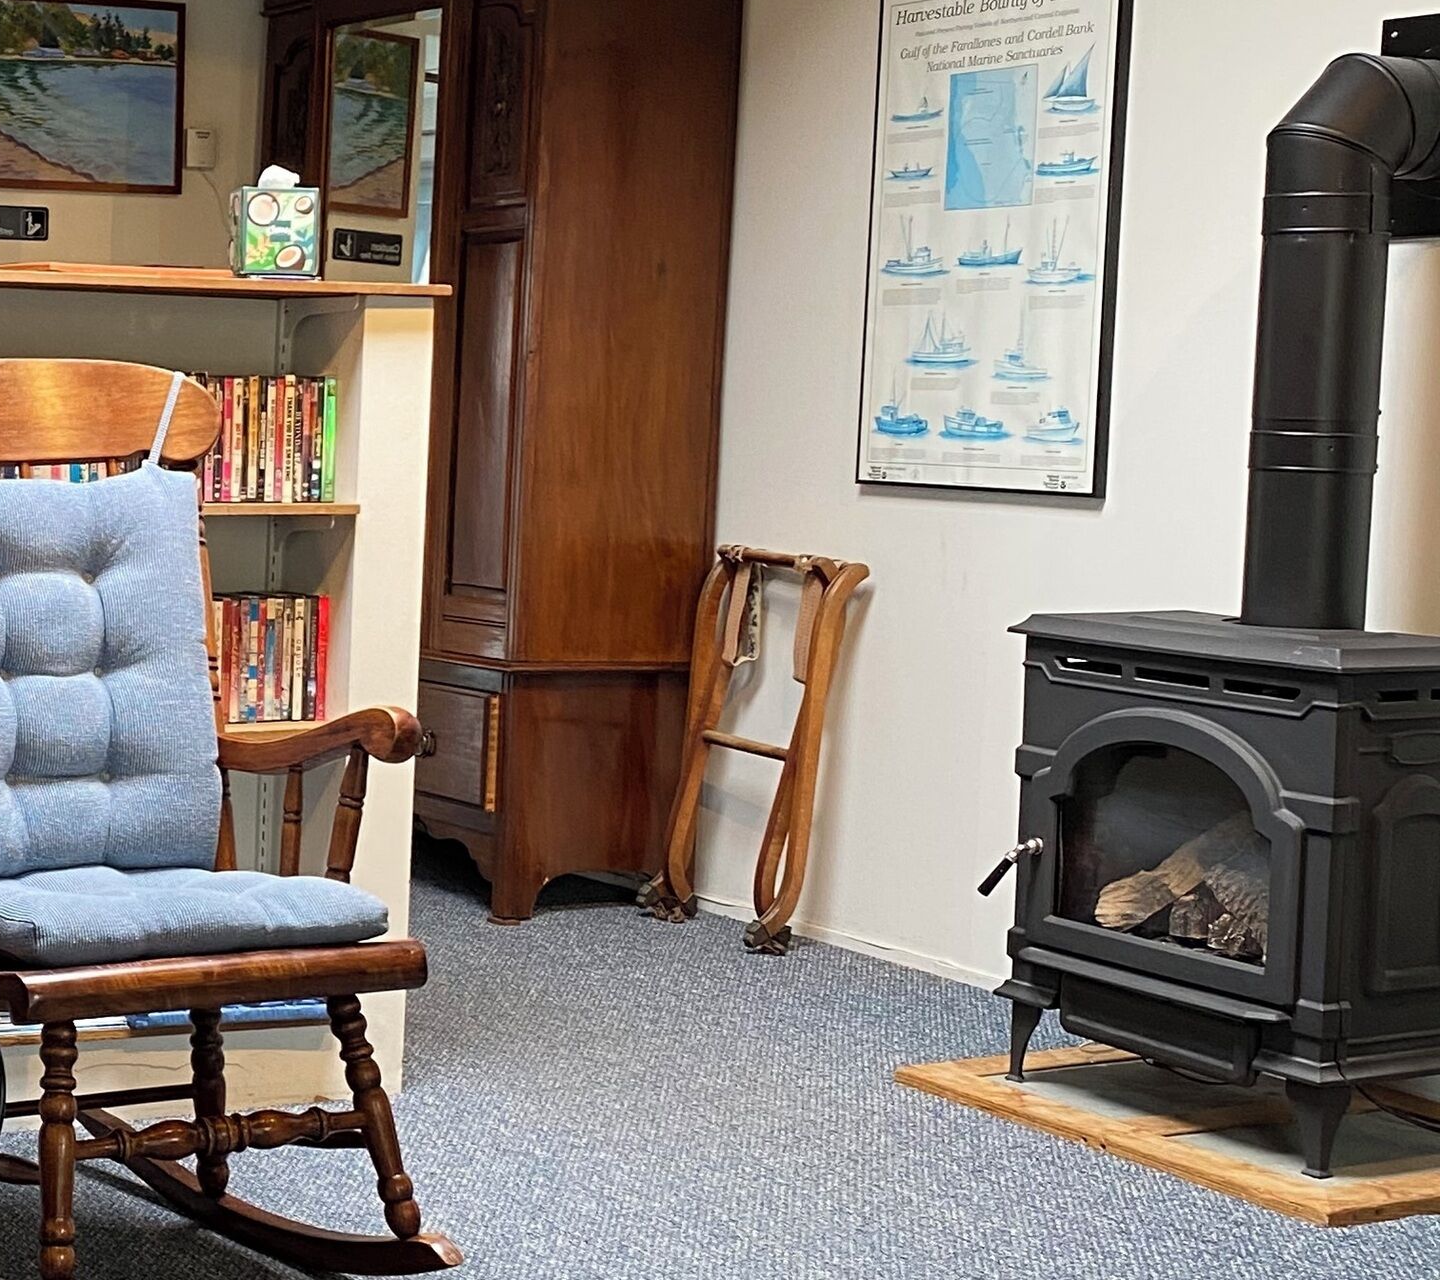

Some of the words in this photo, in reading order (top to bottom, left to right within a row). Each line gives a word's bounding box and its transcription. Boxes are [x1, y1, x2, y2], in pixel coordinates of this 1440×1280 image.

[896, 1, 975, 25] Harvestable
[900, 45, 921, 60] Gulf
[921, 42, 932, 60] of
[933, 44, 948, 56] the
[951, 35, 1002, 54] Farallones
[1004, 31, 1025, 45] and
[1027, 24, 1064, 41] Cordell
[1065, 21, 1095, 37] Bank
[926, 55, 965, 73] National
[967, 52, 1003, 68] Marine
[1006, 45, 1063, 63] Sanctuaries
